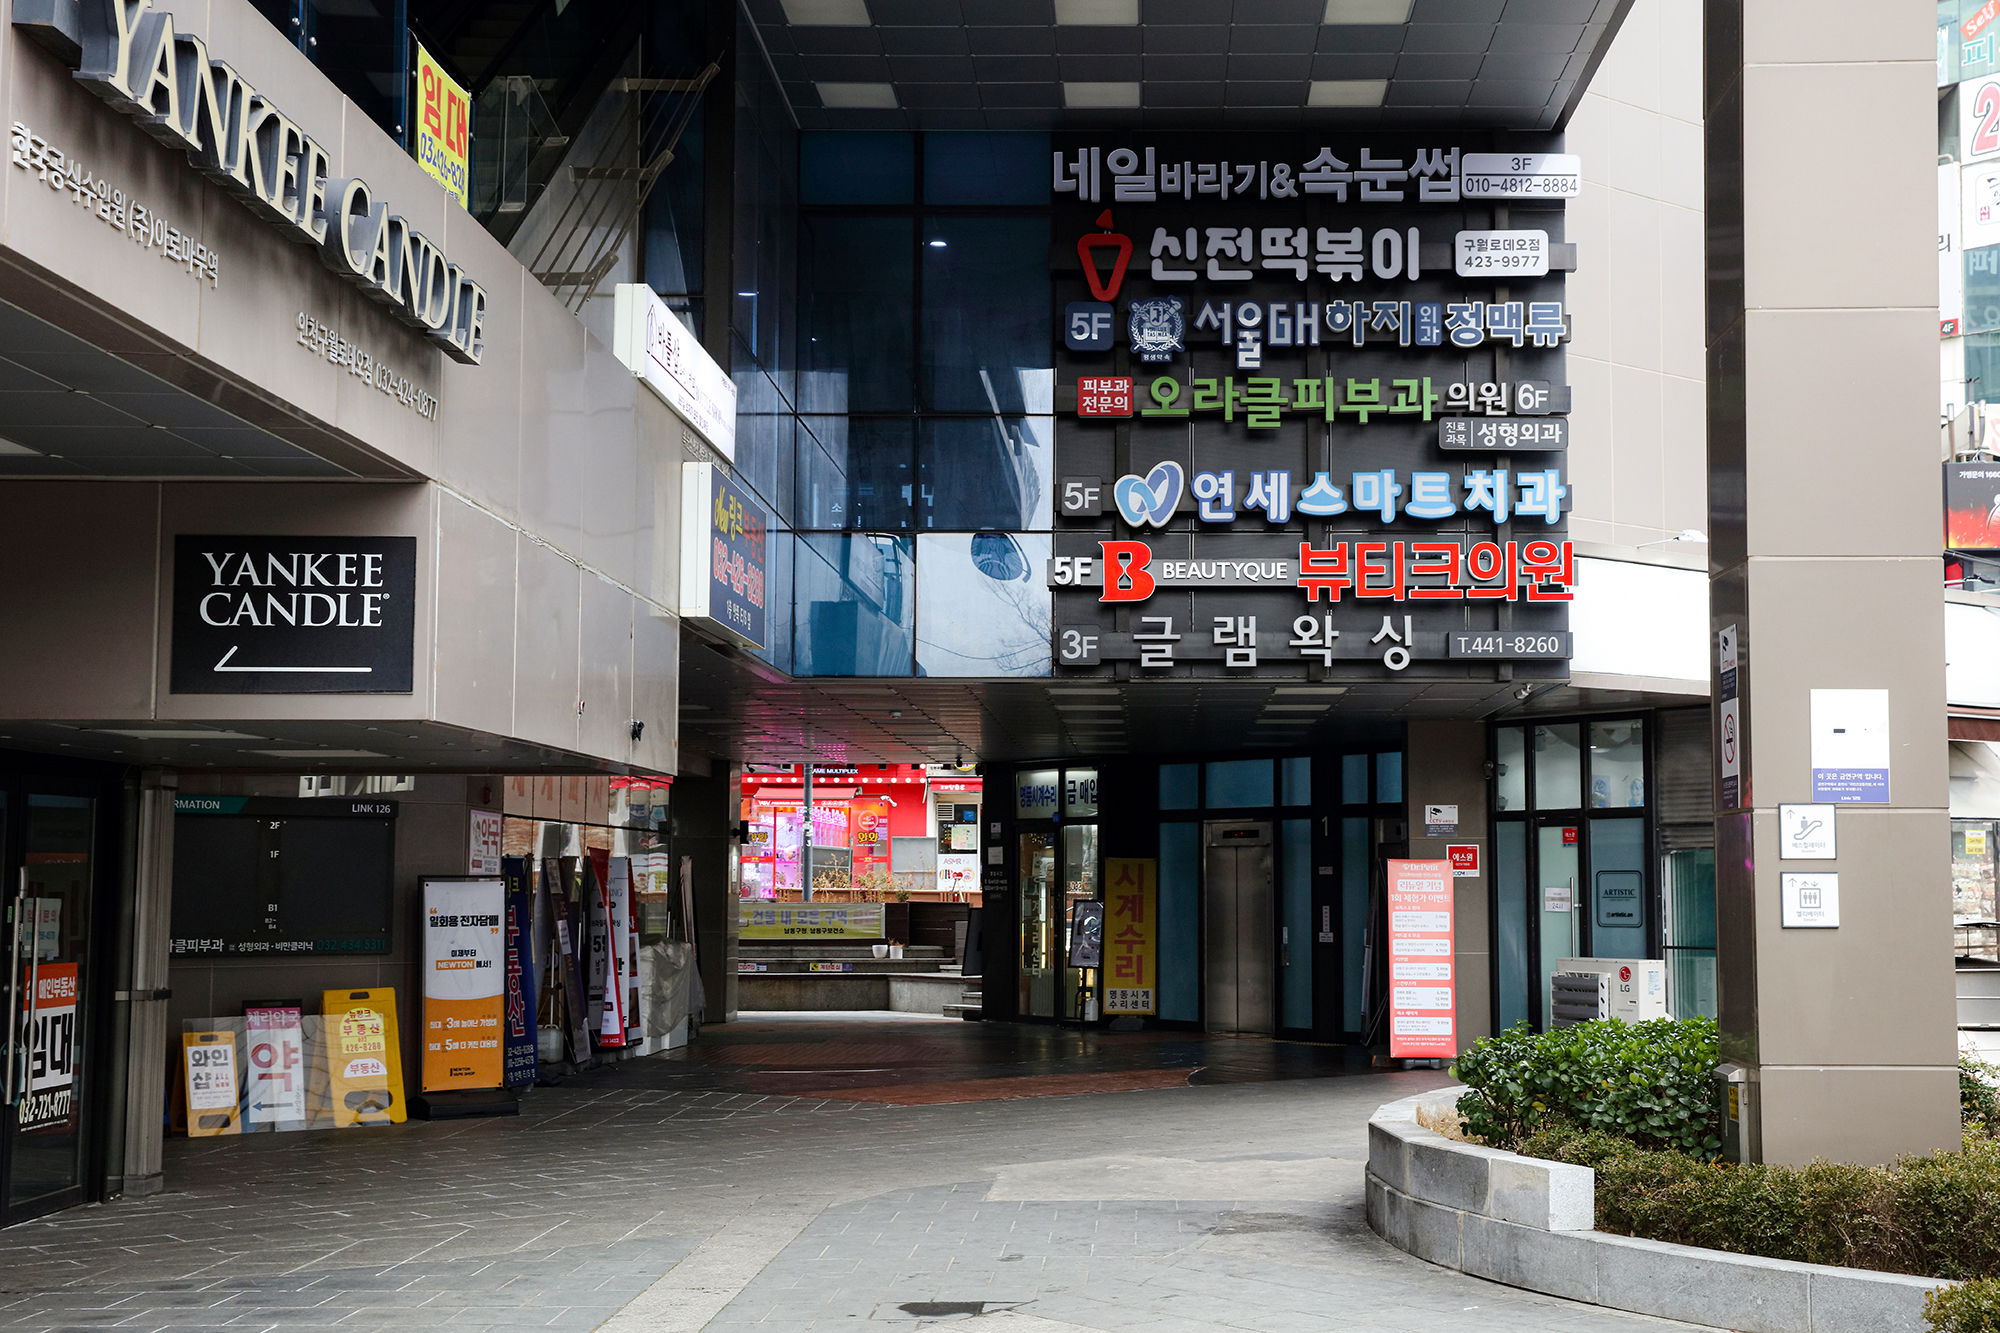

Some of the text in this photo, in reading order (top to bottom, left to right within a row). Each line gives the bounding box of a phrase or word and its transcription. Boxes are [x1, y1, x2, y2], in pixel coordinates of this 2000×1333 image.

[1510, 157, 1532, 172] 3F
[108, 0, 488, 367] YANKEE CANDLE
[1465, 176, 1578, 195] 010-4812-8884
[1464, 238, 1541, 254] 구월로데오점
[1149, 226, 1420, 283] 신전떡볶이
[1464, 255, 1541, 269] 423-9977
[1070, 311, 1111, 340] 5F
[1942, 322, 1954, 333] 4F
[376, 362, 438, 421] 032-424-0877
[1082, 378, 1130, 396] 피부과
[1082, 396, 1130, 413] 전문의
[1141, 376, 1549, 430] 오라클피부과 의원 6F
[1446, 421, 1467, 433] 진료
[1477, 423, 1563, 446] 성형외과
[1446, 434, 1467, 446] 과목
[1063, 482, 1100, 510] 5F
[202, 552, 384, 587] YANKEE
[1053, 556, 1092, 586] 5F
[1162, 562, 1288, 580] BEAUTYQUE
[1297, 540, 1575, 602] 뷰티크의원
[1061, 629, 1099, 658] 3F
[1457, 636, 1560, 655] T.441-8260
[352, 804, 391, 814] LINK 126
[270, 821, 280, 829] 2F
[482, 818, 499, 856] 약국
[270, 851, 279, 859] 1F
[1452, 853, 1473, 861] 에스원
[1410, 863, 1438, 871] Dr.Petit
[1400, 881, 1442, 891] 리뉴얼 기념
[1391, 894, 1451, 903] 1회 체험가 이벤트
[268, 904, 278, 912] B1
[430, 915, 499, 927] 일회용 전자담배
[752, 910, 776, 926] 건물
[781, 910, 792, 926] 내
[797, 910, 820, 926] 모든
[825, 909, 848, 926] 구역
[1114, 863, 1146, 985] 시계수리
[316, 939, 386, 951] 032.434.5311
[451, 949, 477, 958] 이제부터
[437, 960, 473, 969] NEWTON
[1109, 989, 1150, 999] 명동시계
[1620, 984, 1630, 993] LG
[1108, 1000, 1150, 1010] 수리센터
[247, 1011, 299, 1027] 체리약국
[349, 1009, 371, 1019] 뉴링크
[23, 1013, 74, 1080] 임대
[345, 1042, 382, 1051] 426-8288
[192, 1048, 229, 1067] 와인
[250, 1040, 299, 1092] 약
[350, 1062, 380, 1075] 부동산
[18, 1089, 72, 1125] 032-721-8777
